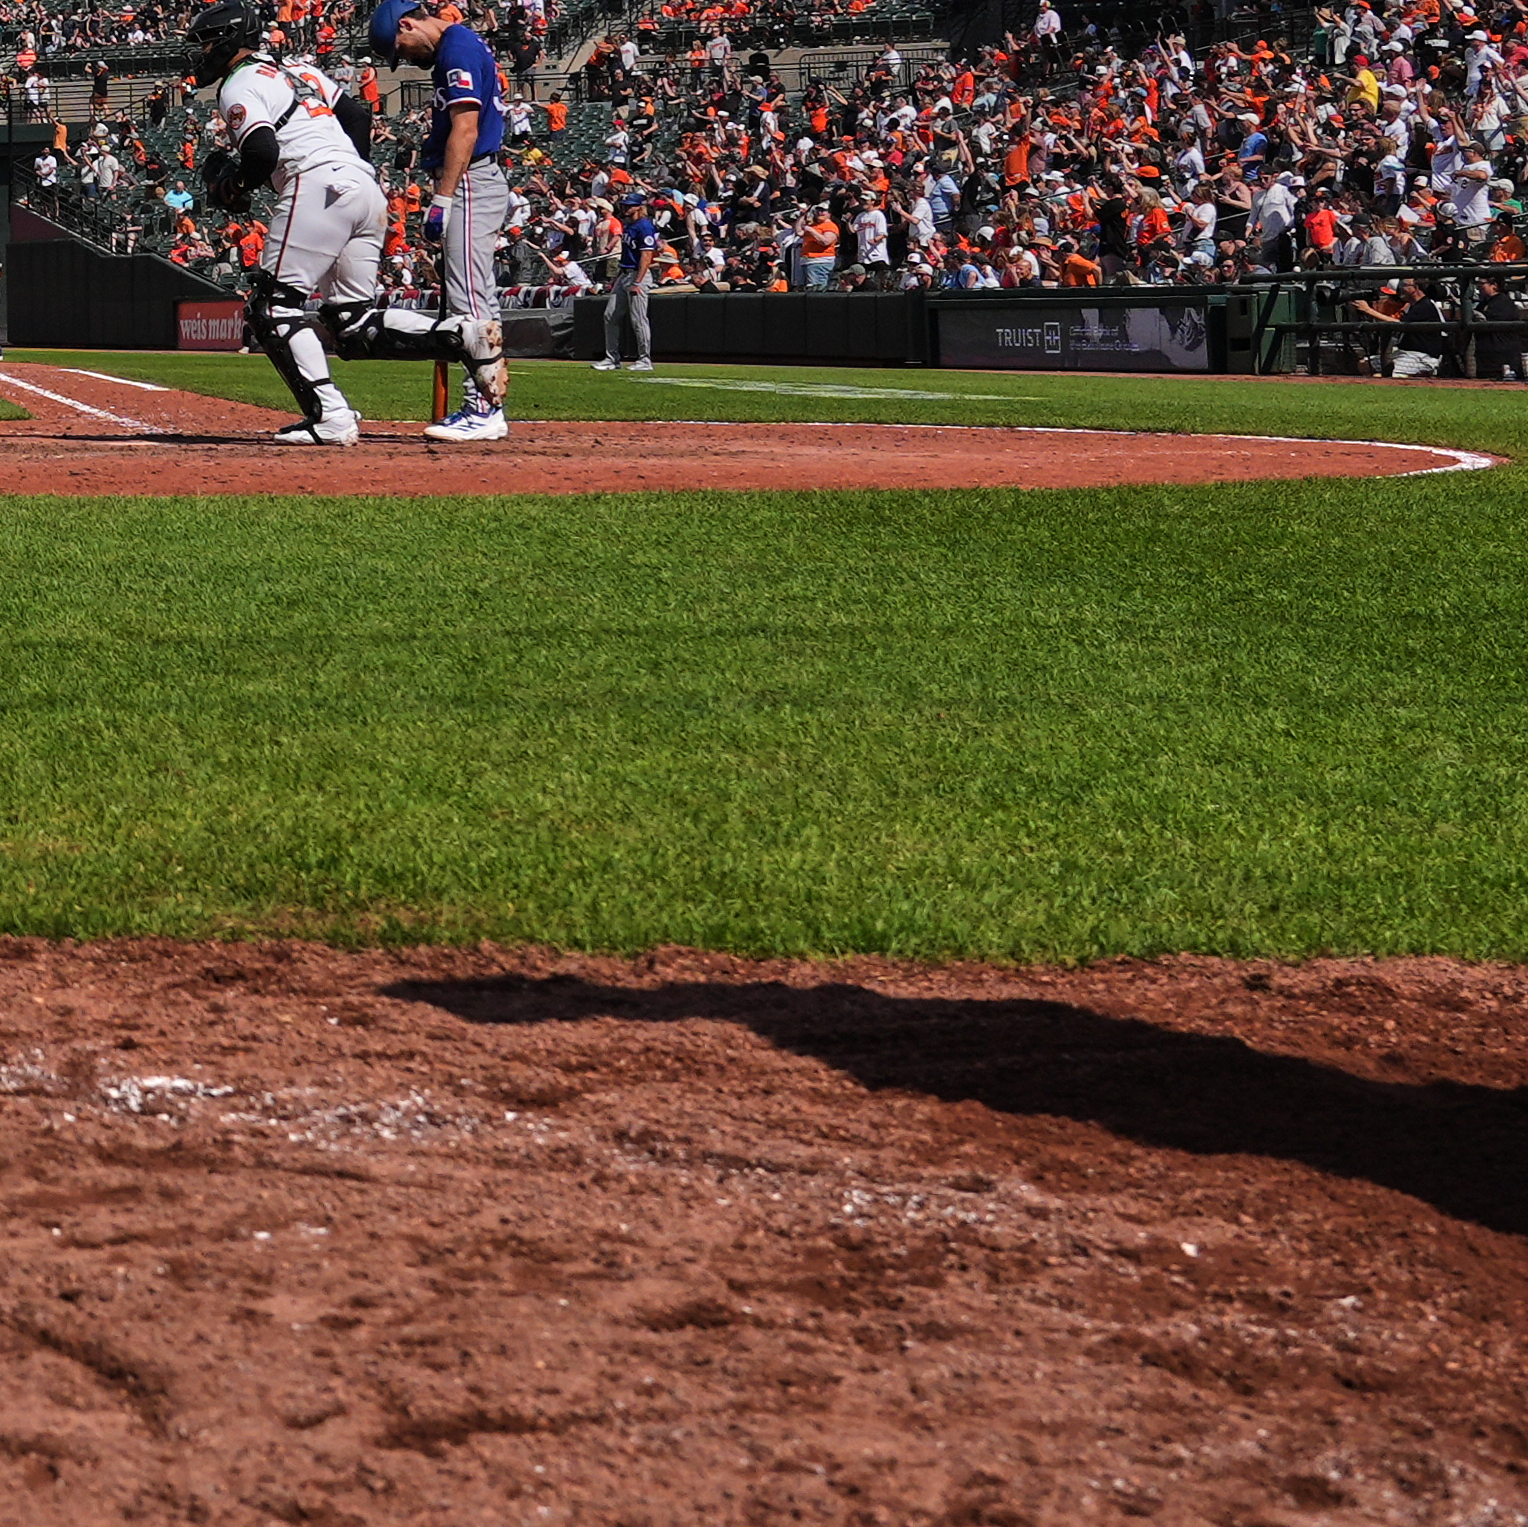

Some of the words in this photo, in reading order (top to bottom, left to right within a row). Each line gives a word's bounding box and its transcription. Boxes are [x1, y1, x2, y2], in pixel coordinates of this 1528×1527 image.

[179, 312, 207, 340] weis
[209, 310, 244, 340] mark
[995, 329, 1042, 346] TRUIST
